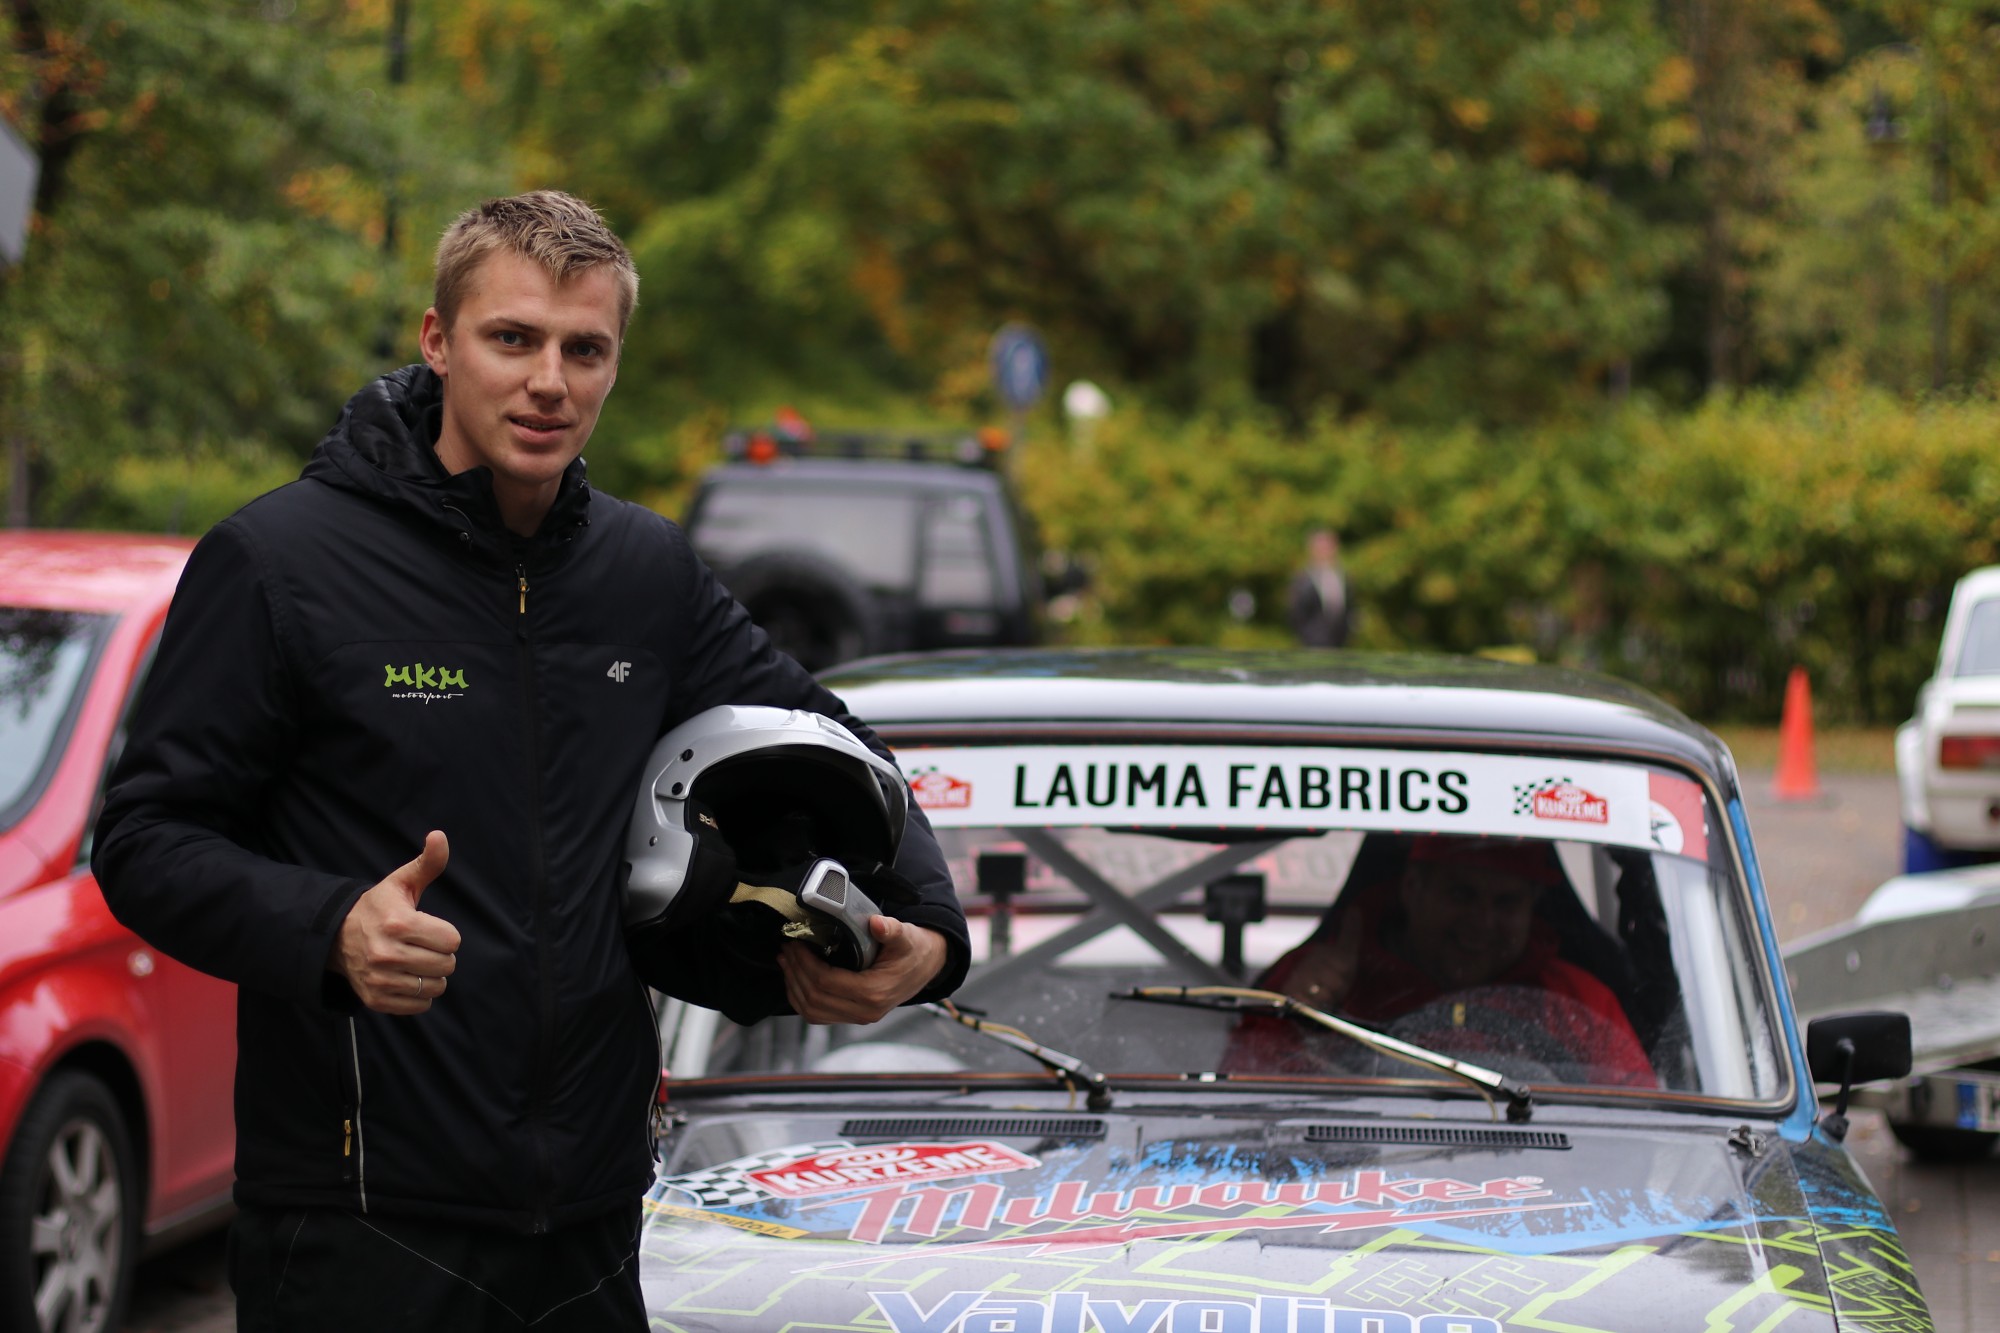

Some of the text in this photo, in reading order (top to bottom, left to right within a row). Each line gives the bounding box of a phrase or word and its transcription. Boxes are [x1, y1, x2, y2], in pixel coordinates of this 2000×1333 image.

[606, 660, 632, 683] 4F
[1013, 763, 1470, 813] LAUMA FABRICS
[762, 1146, 1012, 1192] KURZEME
